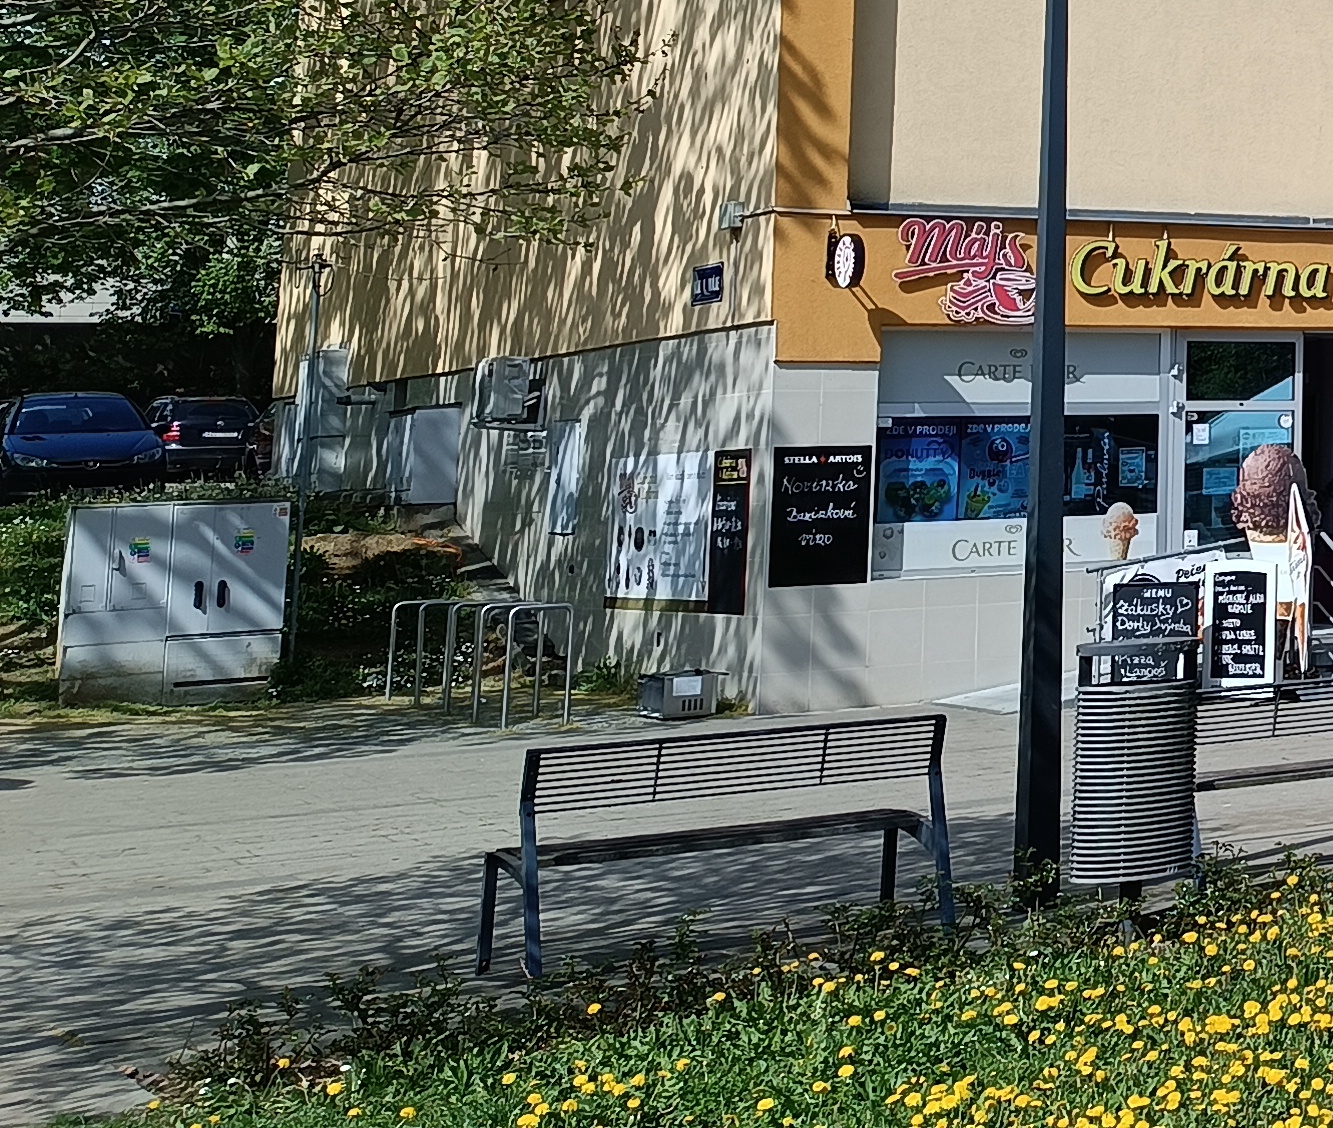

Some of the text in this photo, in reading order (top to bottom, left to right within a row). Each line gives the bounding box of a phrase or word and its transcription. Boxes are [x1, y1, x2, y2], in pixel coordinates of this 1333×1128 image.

[893, 218, 1027, 281] Májs
[1070, 238, 1331, 300] Cukrárna
[957, 360, 1022, 384] CARTE
[886, 425, 957, 436] ZDE V PRODEJI
[986, 424, 993, 432] V
[994, 424, 1031, 433] PRODEJ
[784, 454, 863, 464] STELLA ARTOIS
[951, 539, 1017, 561] CARTE
